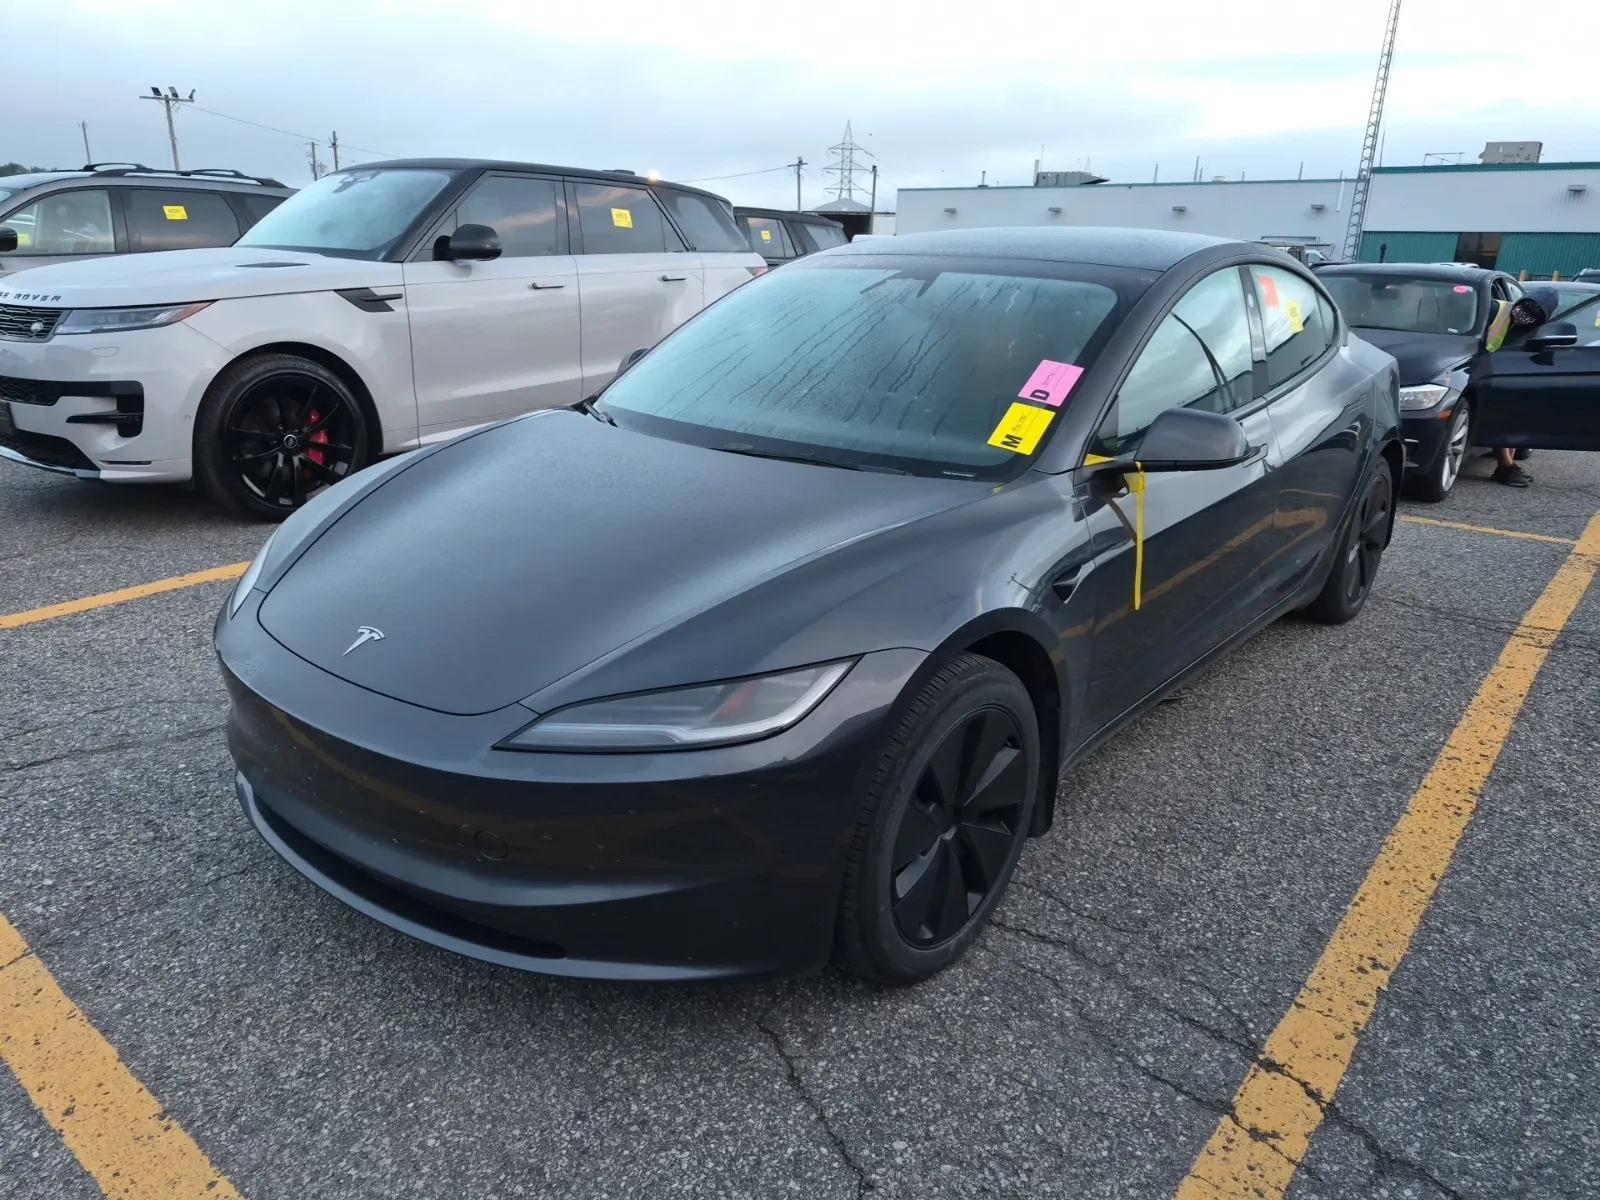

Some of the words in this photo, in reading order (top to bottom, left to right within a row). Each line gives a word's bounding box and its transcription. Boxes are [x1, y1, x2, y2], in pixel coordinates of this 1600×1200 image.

[14, 293, 62, 301] ROVER
[1030, 389, 1050, 401] D
[1000, 434, 1023, 448] M
